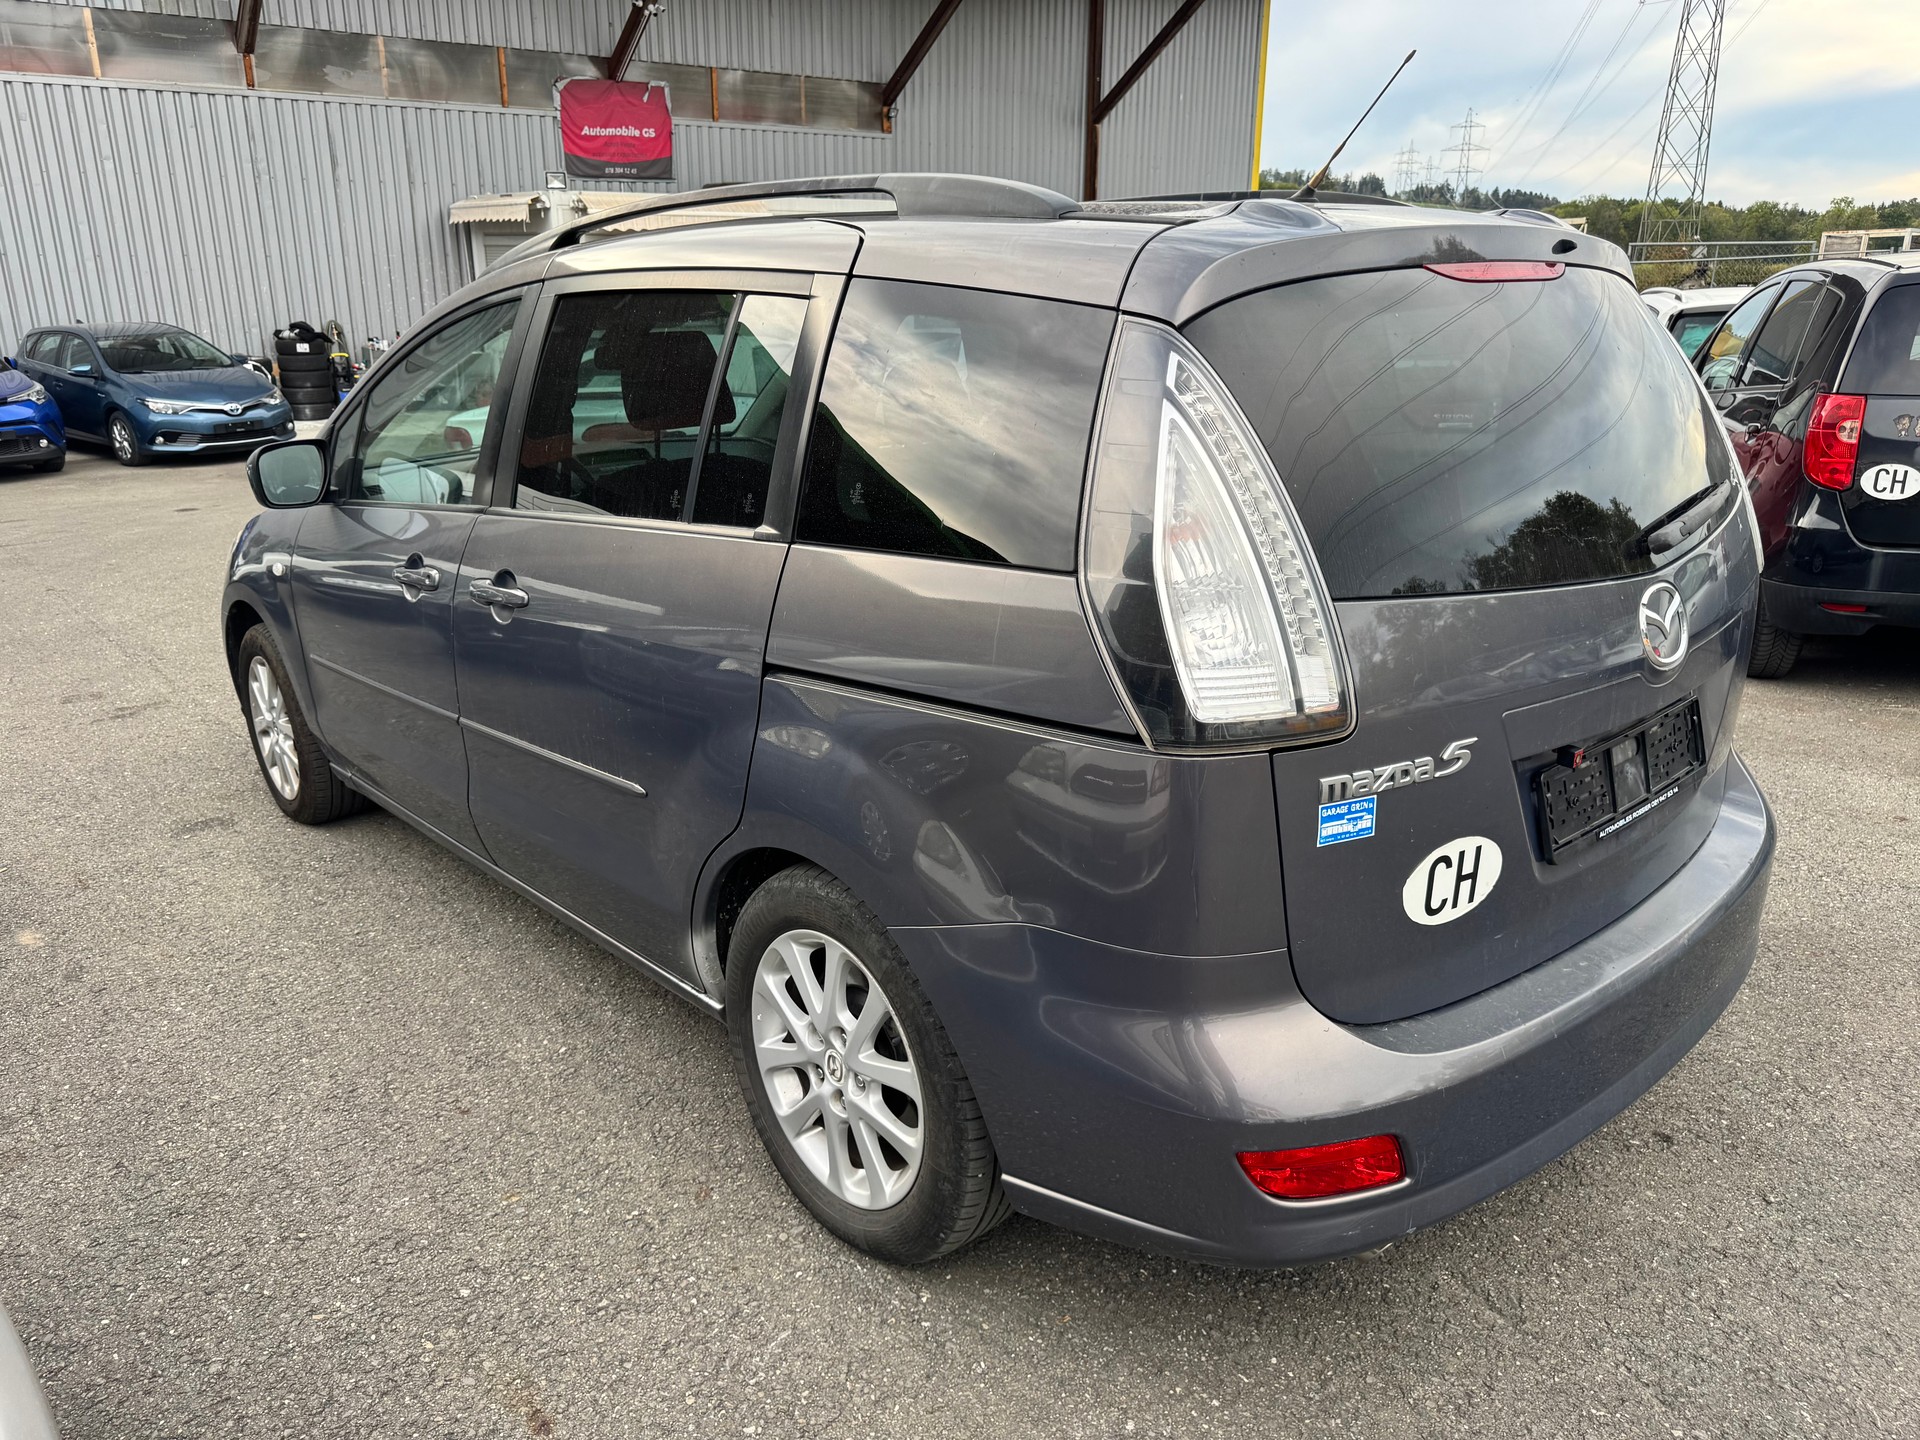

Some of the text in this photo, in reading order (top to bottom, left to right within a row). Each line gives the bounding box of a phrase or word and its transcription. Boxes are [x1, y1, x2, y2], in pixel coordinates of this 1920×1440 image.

[581, 125, 656, 138] Automobile GS
[1873, 468, 1908, 494] CH
[1321, 805, 1349, 817] GARAGE
[1350, 801, 1368, 812] GRIN
[1599, 814, 1633, 838] AUTOMOBILES
[1424, 844, 1483, 917] CH
